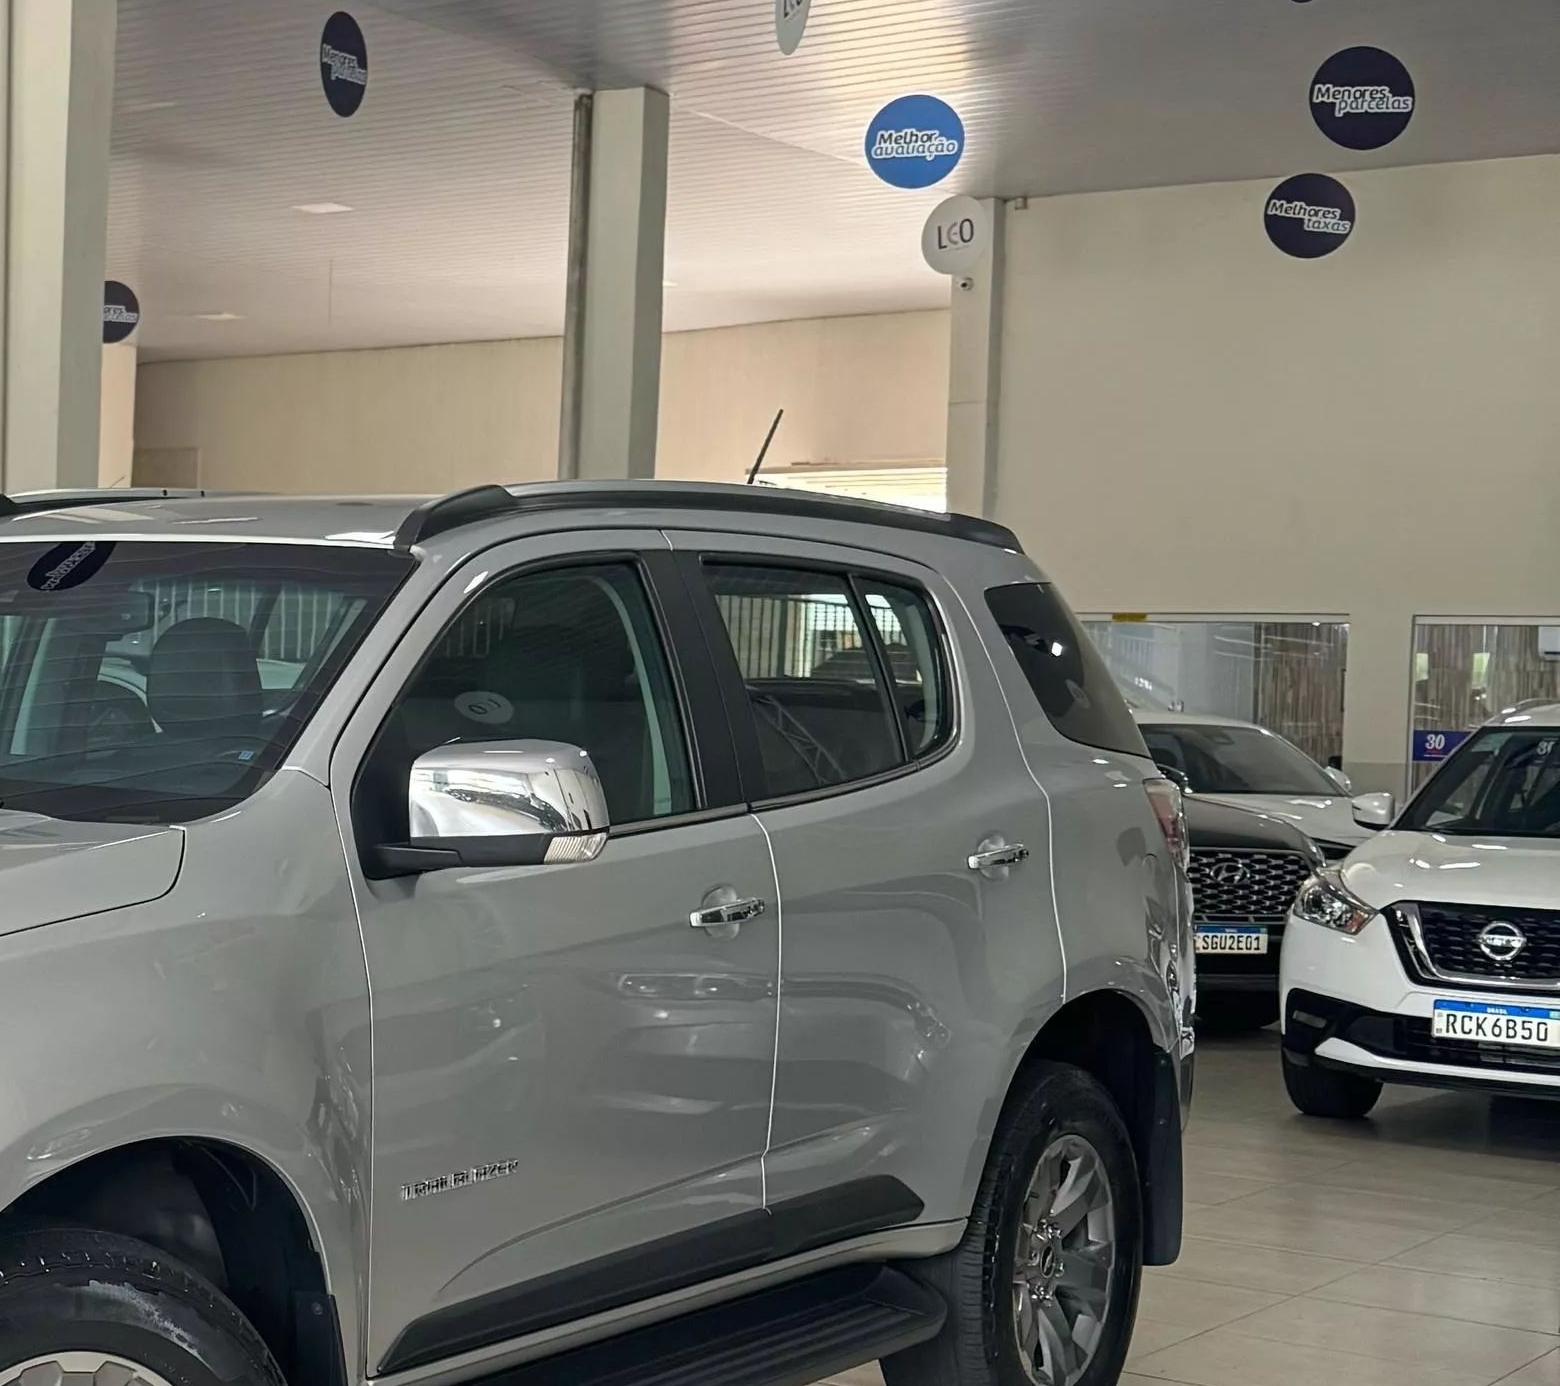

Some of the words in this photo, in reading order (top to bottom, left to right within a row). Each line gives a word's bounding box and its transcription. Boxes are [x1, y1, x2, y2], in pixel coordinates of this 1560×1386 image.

[1315, 86, 1388, 103] Menores
[1337, 94, 1411, 115] parcelas
[878, 130, 937, 146] Melhor
[874, 139, 956, 159] avaliação
[1270, 201, 1340, 220] Melhores
[1305, 218, 1350, 232] taxas
[1425, 733, 1445, 750] 30
[1202, 934, 1261, 951] SGU2E01
[1445, 1013, 1548, 1042] RCK6B50
